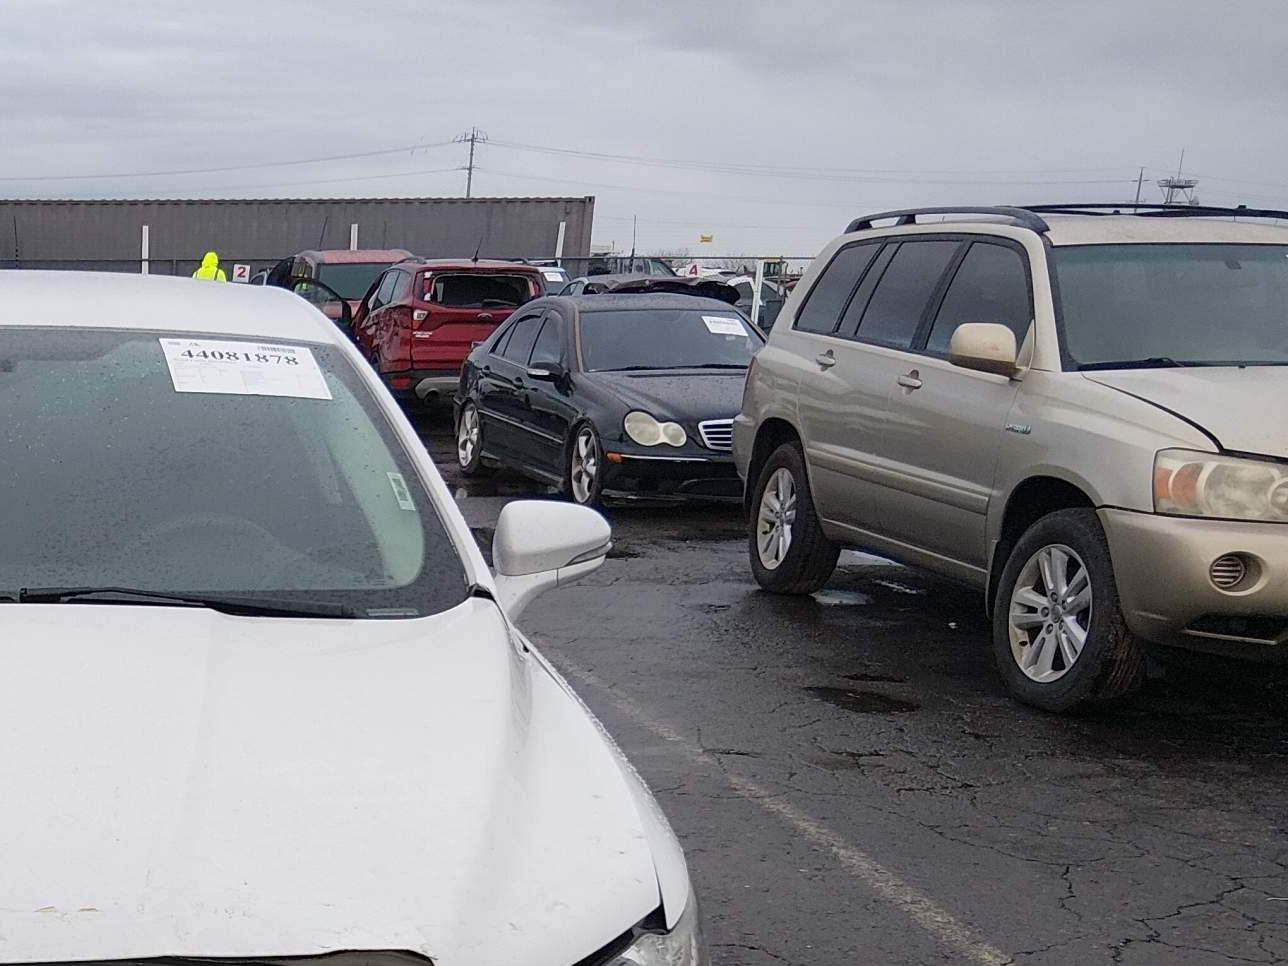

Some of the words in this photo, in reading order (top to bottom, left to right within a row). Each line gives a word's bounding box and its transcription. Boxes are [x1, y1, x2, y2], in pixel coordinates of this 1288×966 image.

[237, 266, 247, 279] 2
[688, 264, 698, 276] 4
[180, 348, 300, 367] 44081878
